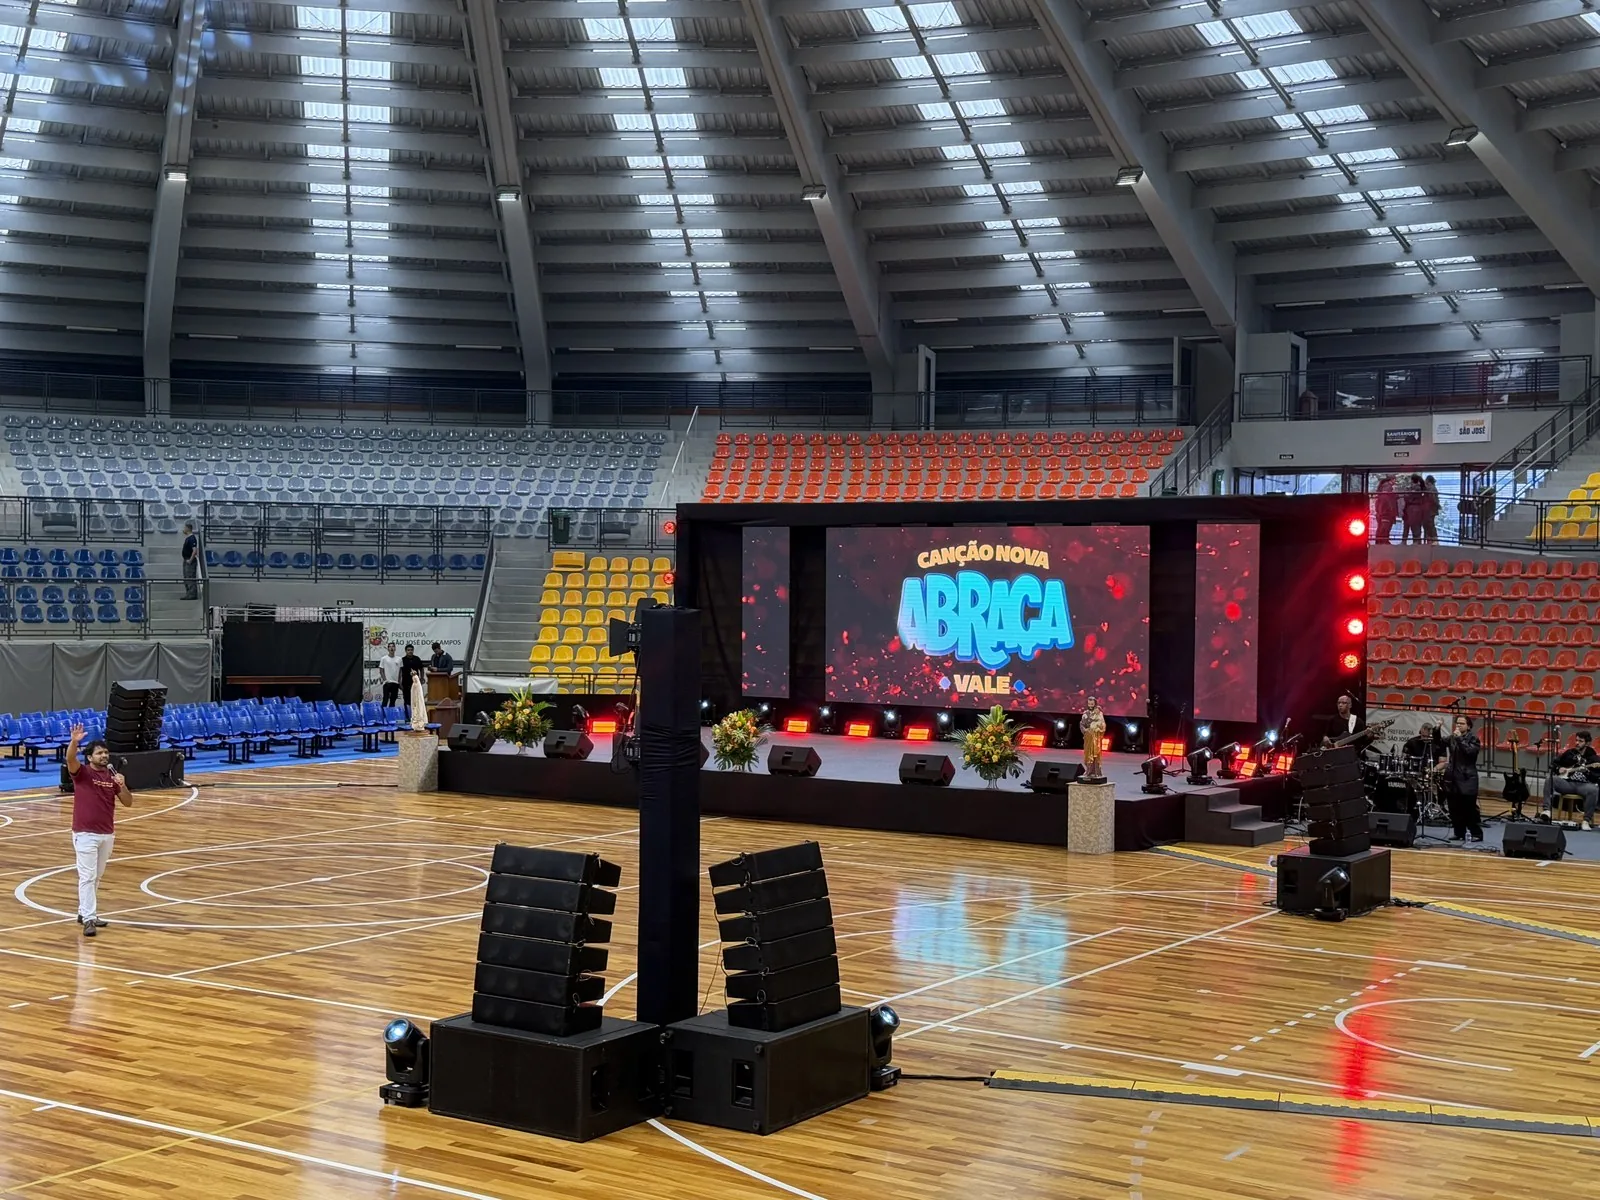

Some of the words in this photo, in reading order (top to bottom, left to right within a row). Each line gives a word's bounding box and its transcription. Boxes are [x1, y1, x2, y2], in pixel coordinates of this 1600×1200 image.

[1459, 426, 1470, 435] SÃO
[1471, 426, 1486, 435] JOSÉ
[917, 540, 994, 569] CANÇÃO
[995, 545, 1050, 569] NOVA
[897, 570, 1074, 670] ABRAÇA
[953, 673, 1011, 695] VALE
